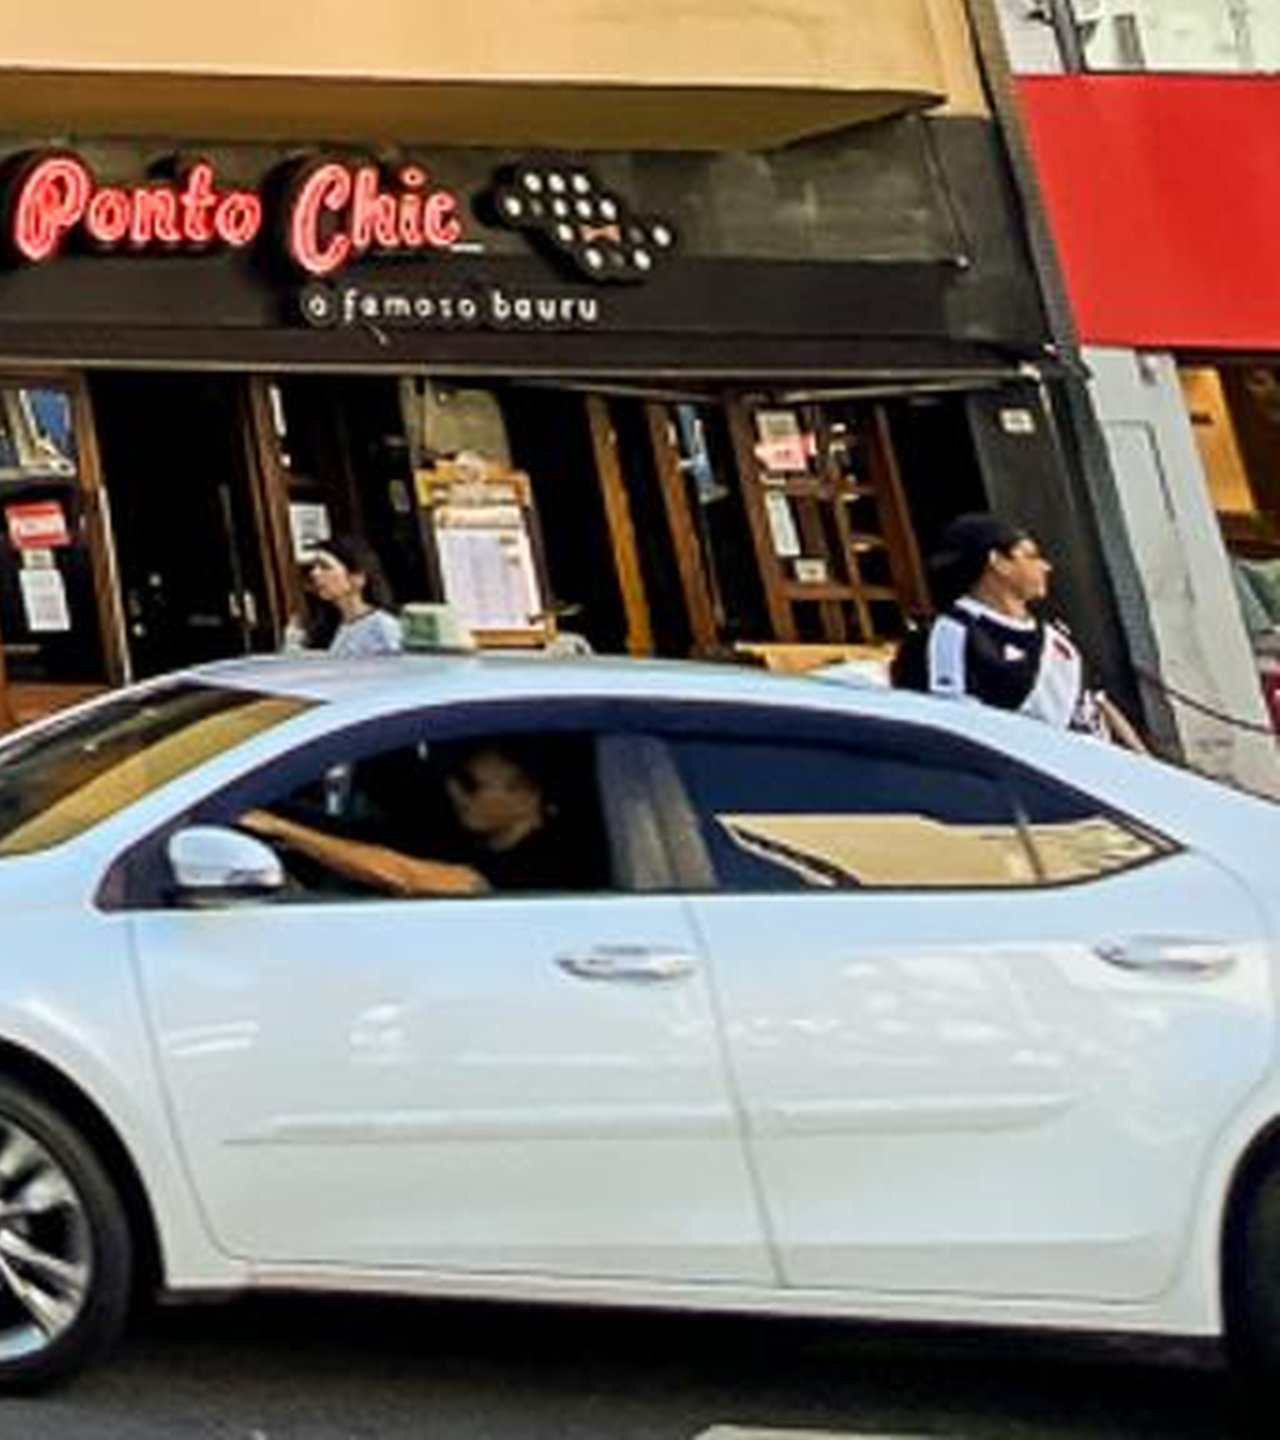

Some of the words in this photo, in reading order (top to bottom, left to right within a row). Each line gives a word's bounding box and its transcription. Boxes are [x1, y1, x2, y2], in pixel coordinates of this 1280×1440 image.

[14, 157, 263, 260] Ponto
[290, 162, 462, 275] Chic
[343, 288, 478, 322] famoso
[493, 289, 598, 321] bauru
